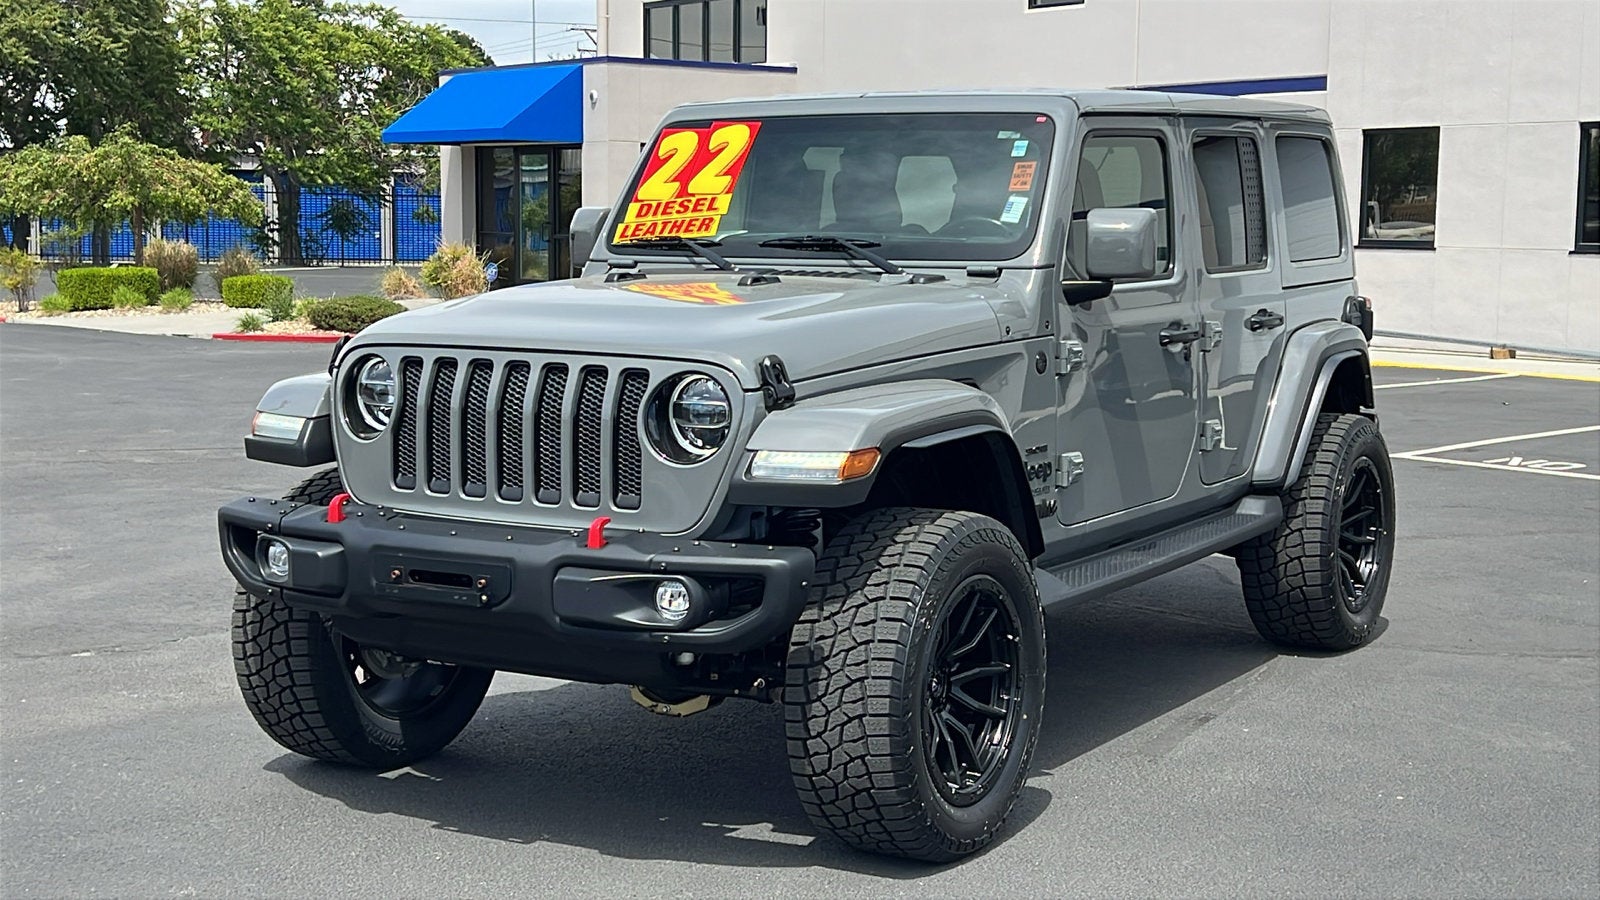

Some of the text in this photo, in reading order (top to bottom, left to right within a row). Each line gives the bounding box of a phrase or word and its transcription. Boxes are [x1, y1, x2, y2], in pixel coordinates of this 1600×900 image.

[637, 124, 751, 201] 22
[635, 197, 718, 218] DIESEL
[619, 216, 716, 239] LEATHER
